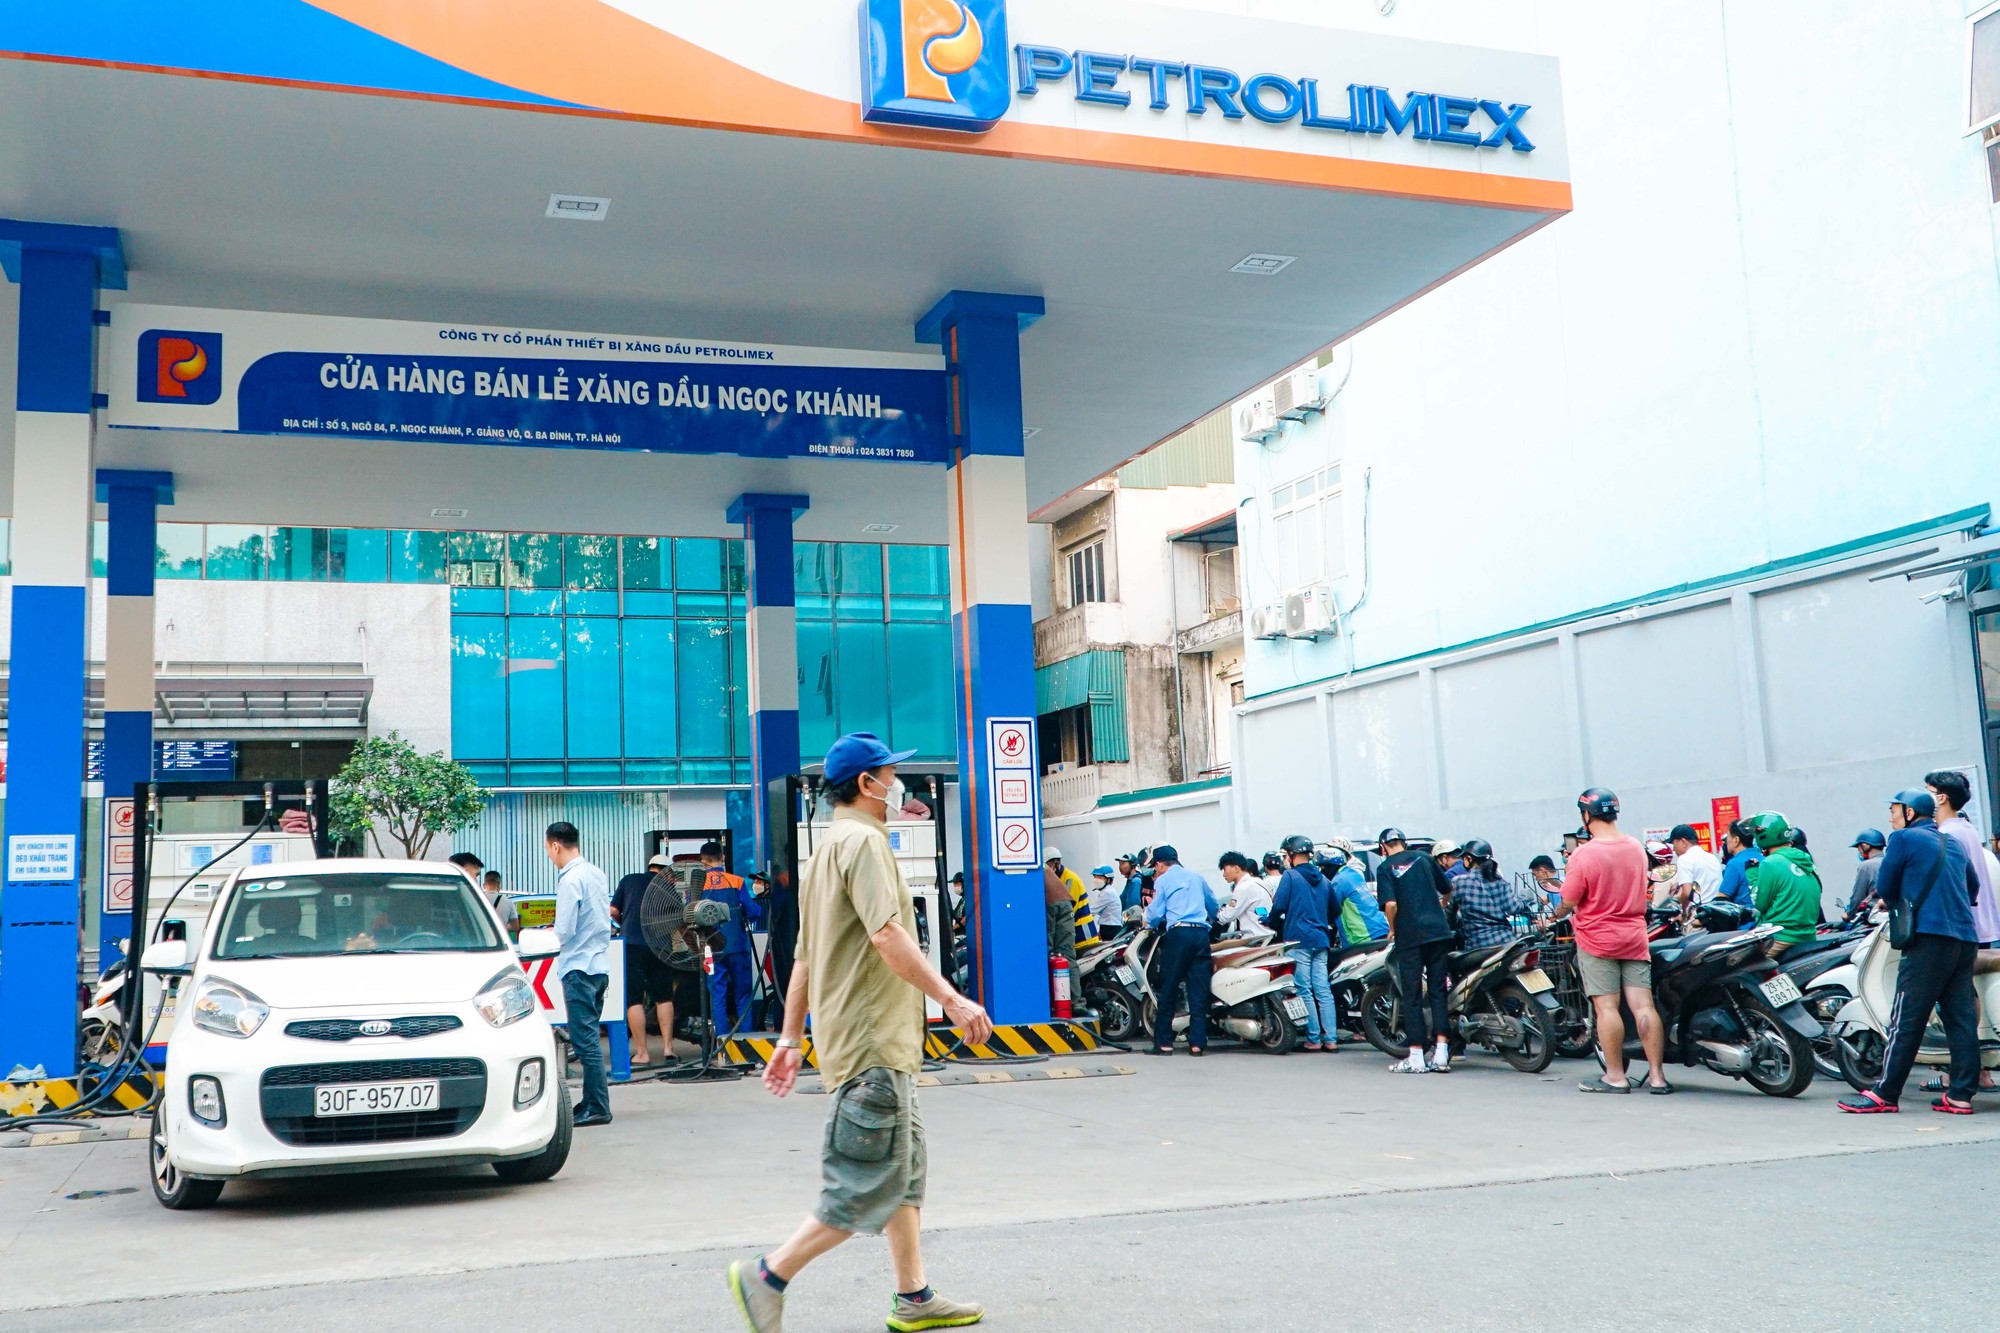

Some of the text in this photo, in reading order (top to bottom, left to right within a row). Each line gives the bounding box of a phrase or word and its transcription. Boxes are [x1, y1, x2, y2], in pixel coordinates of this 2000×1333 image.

[1014, 42, 1536, 154] PETROLIMEX
[439, 329, 478, 341] CÔNG
[481, 333, 499, 343] TY
[503, 331, 522, 345] CỔ
[566, 336, 604, 350] THIẾT
[608, 341, 621, 353] BỊ
[625, 341, 661, 353] XĂNG
[695, 346, 774, 360] PETROLIMEX
[319, 354, 881, 418] CỬA HÀNG BÁN LẺ XĂNG DẦU NGỌC KHÁNH
[282, 418, 300, 429] ĐỊA
[301, 417, 319, 429] CHỈ
[325, 418, 339, 430] SỐ
[374, 422, 388, 433] 84,
[389, 423, 399, 433] P.
[400, 424, 427, 436] NGỌC
[429, 424, 464, 437] KHÁNH,
[466, 427, 474, 436] P.
[524, 430, 533, 440] Q.
[535, 431, 548, 440] BA
[575, 433, 589, 442] TP.
[591, 432, 604, 443] HÀ
[605, 432, 621, 444] NỘI
[808, 443, 828, 455] ĐIỆN
[829, 445, 855, 456] THOẠI
[860, 447, 874, 456] 024
[876, 448, 894, 457] 3831
[896, 449, 914, 458] 7850
[1764, 977, 1790, 994] 29-F1
[1770, 986, 1800, 1006] 389.71
[362, 1024, 388, 1034] KIA
[319, 1084, 435, 1112] 30F-957.07
